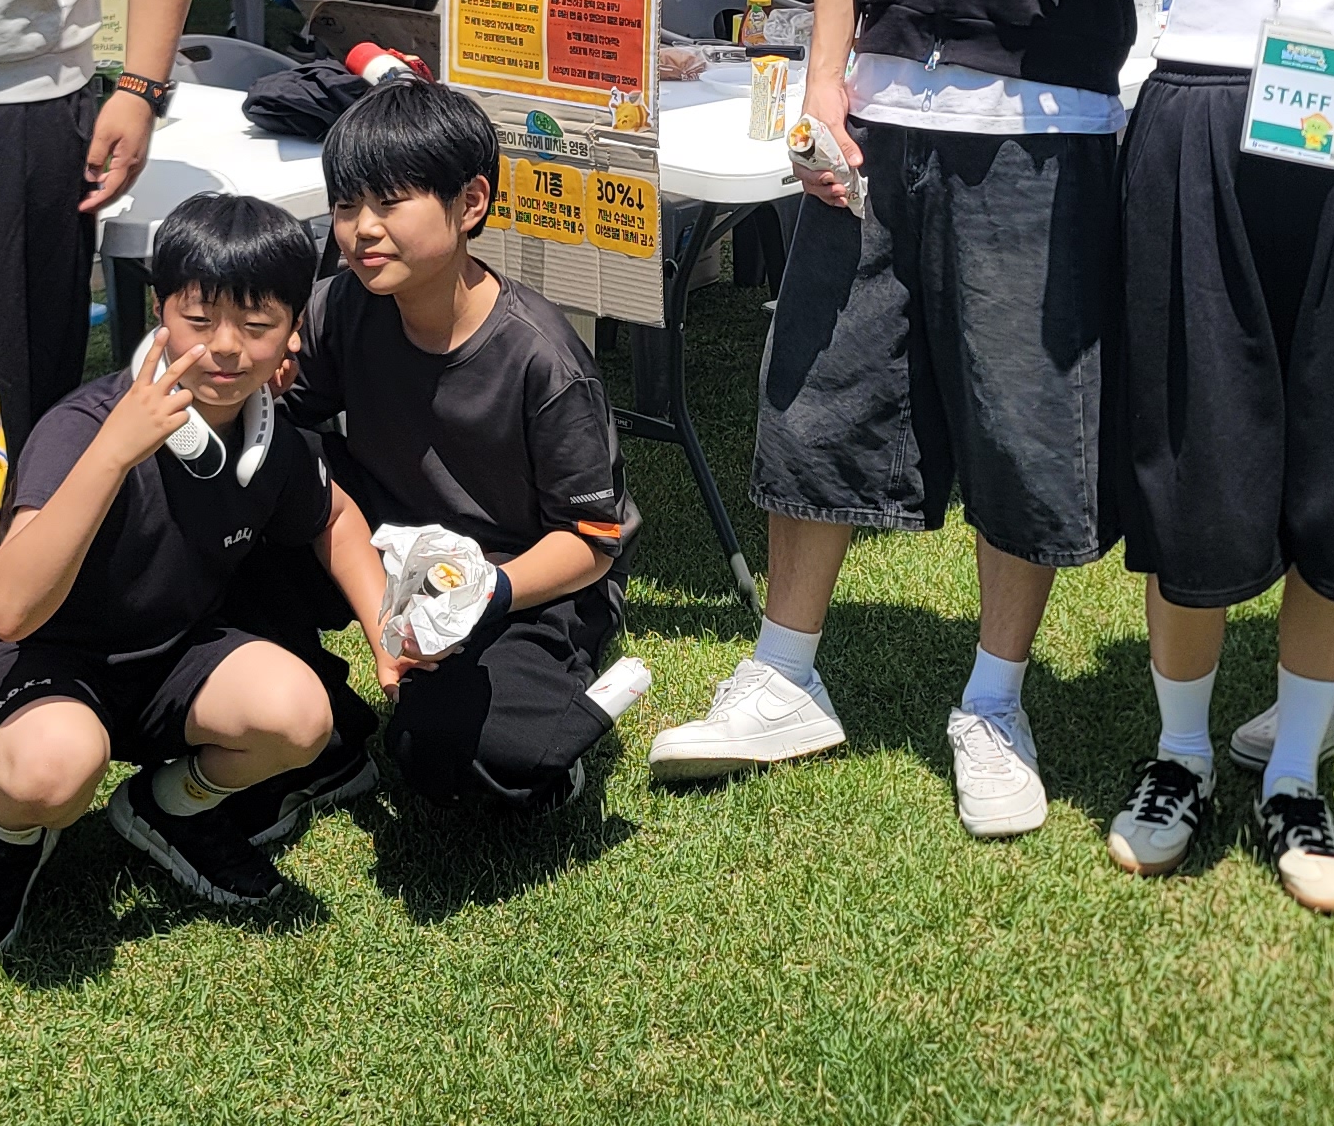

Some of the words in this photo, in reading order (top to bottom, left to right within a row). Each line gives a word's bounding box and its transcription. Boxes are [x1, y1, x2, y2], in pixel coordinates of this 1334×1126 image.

[1263, 84, 1332, 112] STAFF
[518, 133, 543, 149] 지구에
[544, 136, 568, 153] 미치는
[569, 140, 589, 157] 영향
